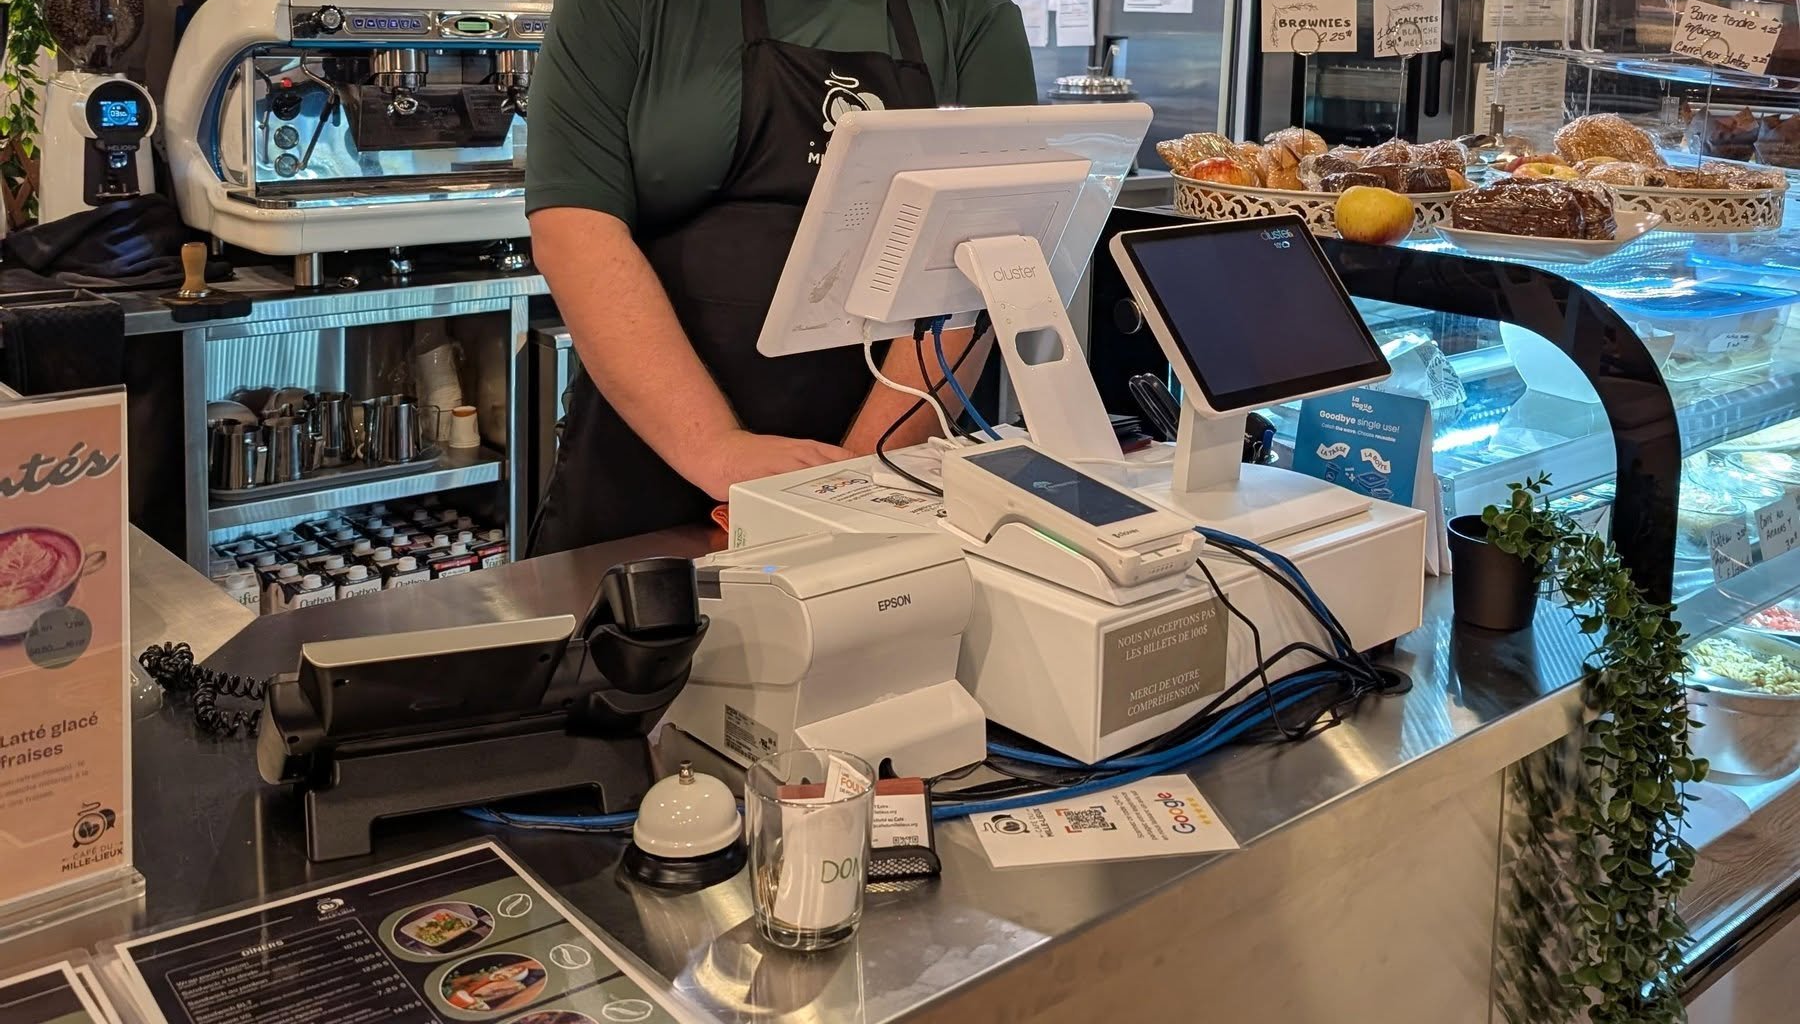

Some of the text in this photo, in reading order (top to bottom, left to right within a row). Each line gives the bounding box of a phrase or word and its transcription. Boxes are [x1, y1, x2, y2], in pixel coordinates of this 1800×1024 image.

[1278, 18, 1351, 28] BROWNIES
[994, 266, 1036, 282] cluster
[1320, 410, 1400, 433] Goodbye single use!
[1328, 446, 1347, 456] TASSE
[878, 593, 912, 612] EPSON
[1117, 608, 1216, 648] NOUS N'ACCEPTONS PAS
[1126, 624, 1208, 661] LES BILLETS DE 100$
[1128, 681, 1200, 717] COMPRÉHENSION
[1130, 668, 1200, 702] MERCI DE VOTRE
[0, 712, 98, 749] Latté glacé
[0, 742, 64, 770] fraises
[1154, 792, 1196, 834] Google
[62, 848, 123, 872] MILLE-LIEUX
